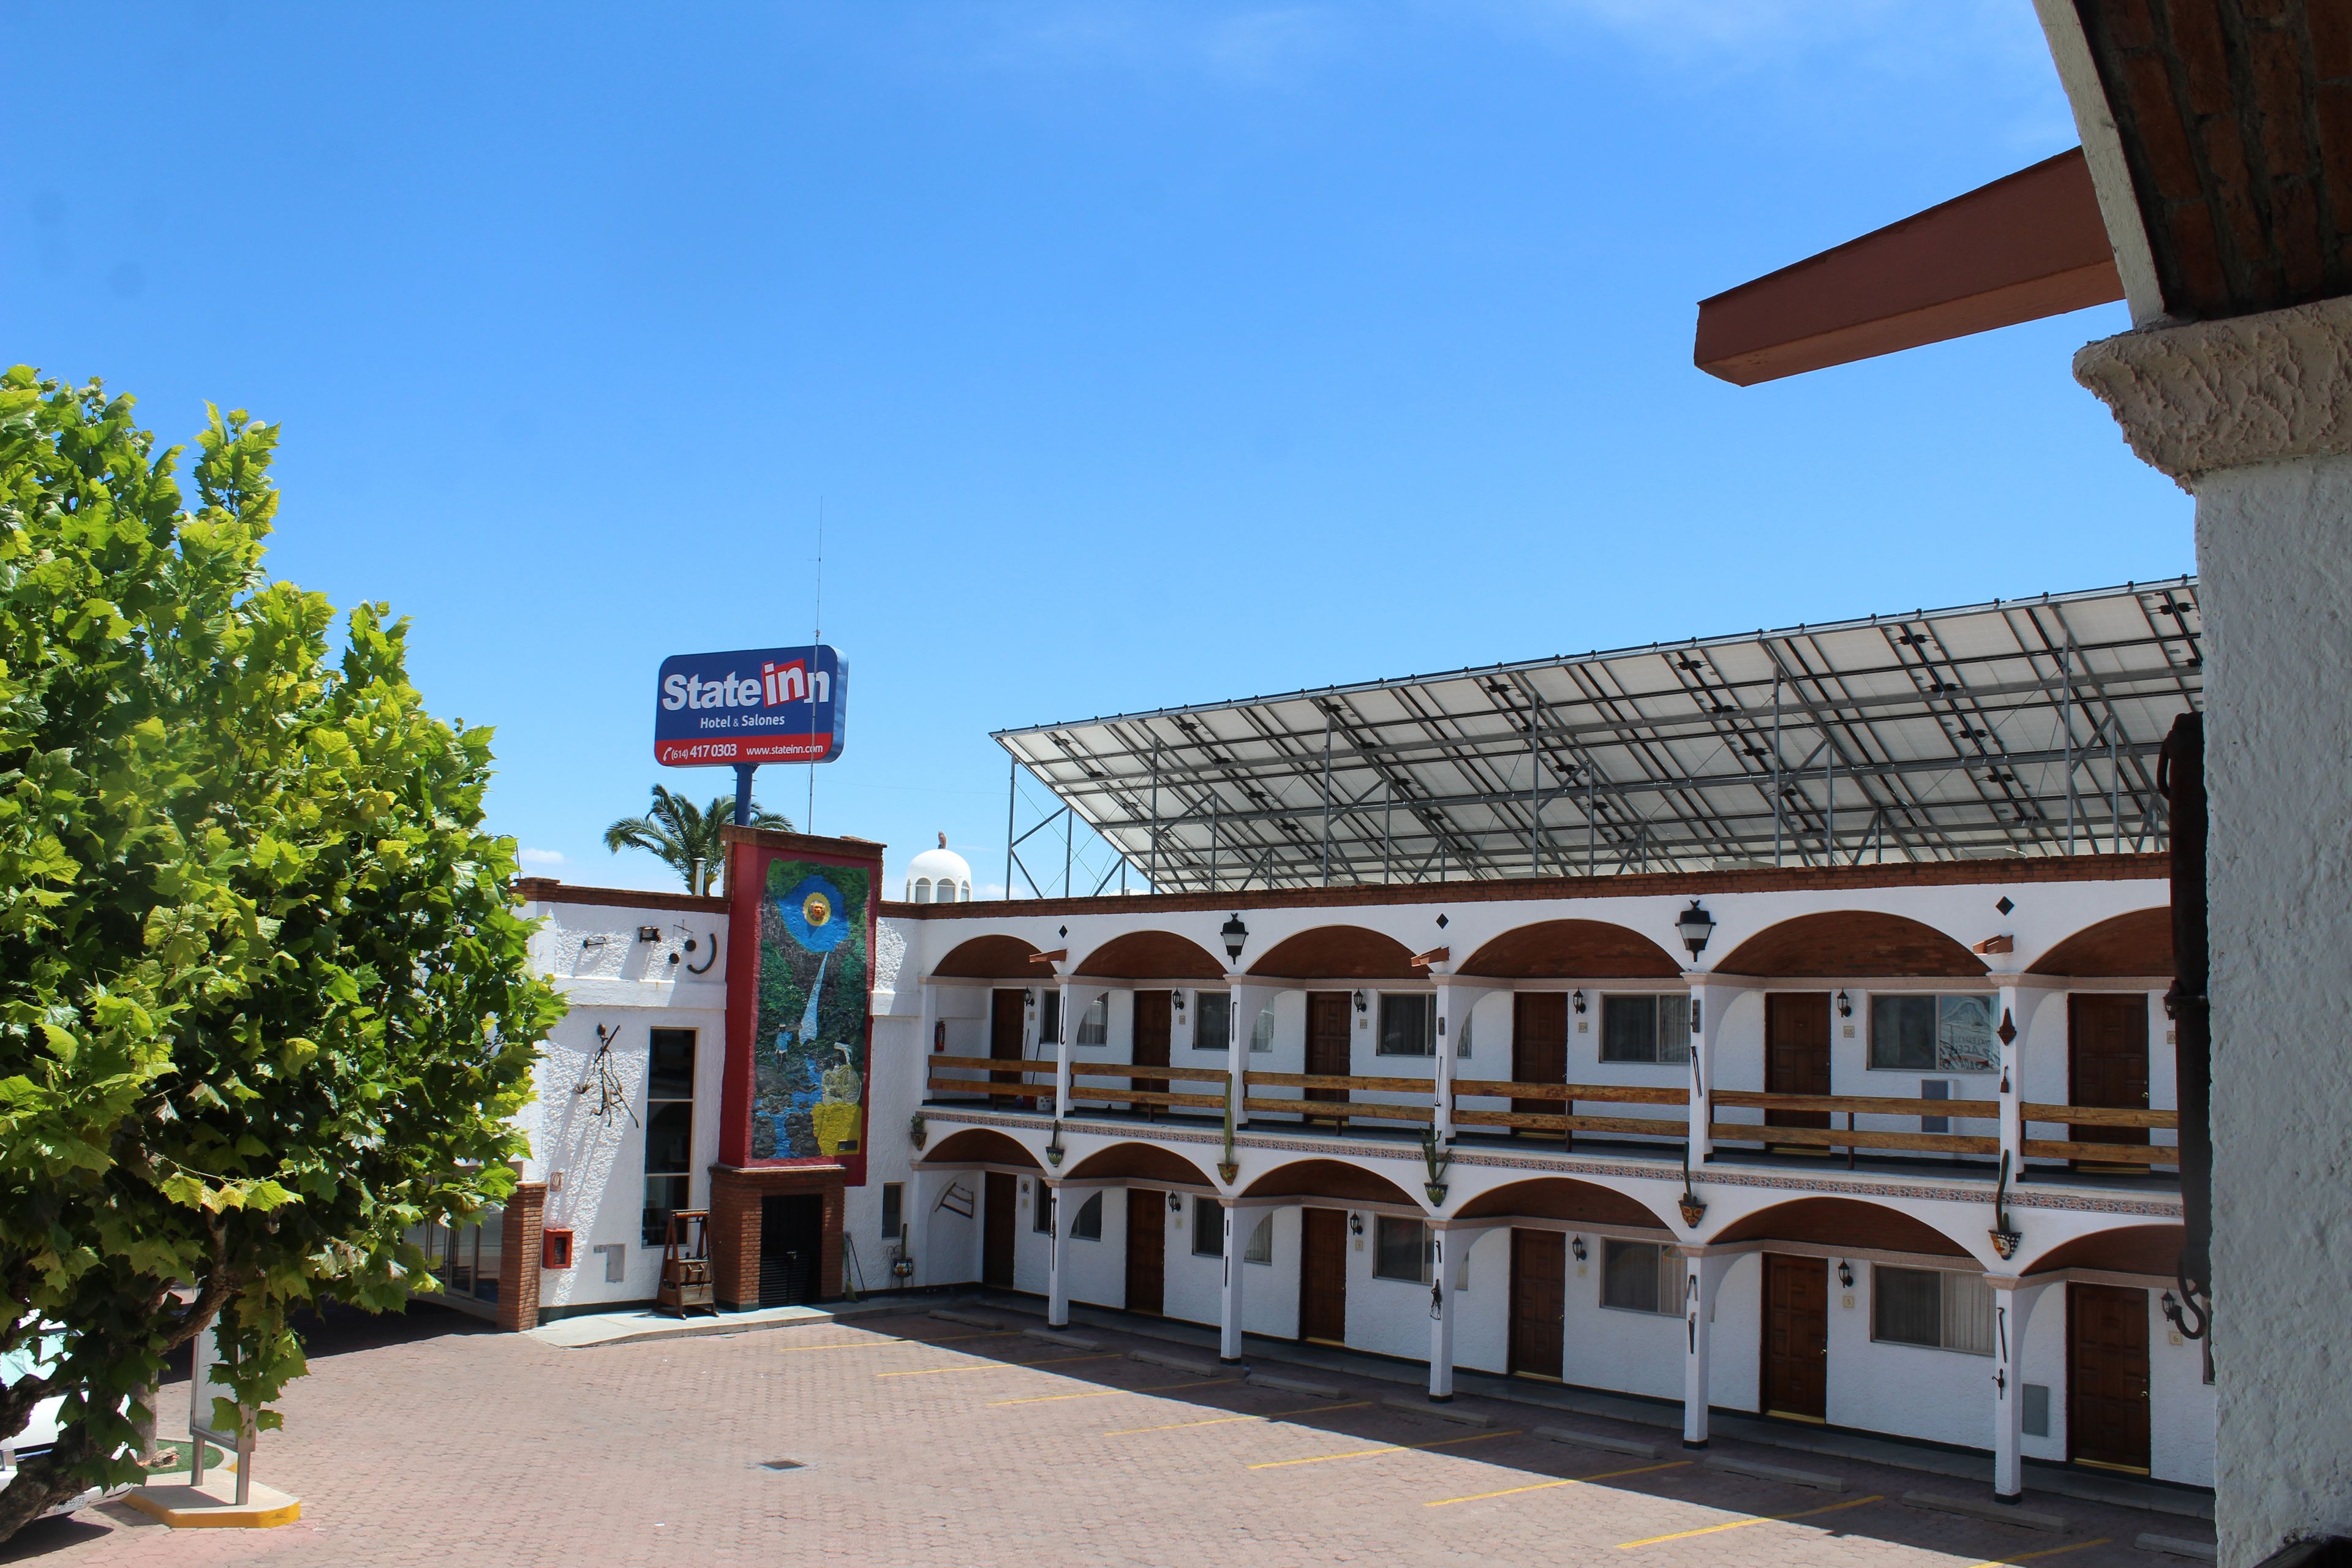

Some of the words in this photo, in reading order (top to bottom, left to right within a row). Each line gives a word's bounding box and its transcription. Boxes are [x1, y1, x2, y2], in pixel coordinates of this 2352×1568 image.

[700, 717, 730, 729] Hotel
[733, 719, 739, 728] &
[741, 714, 785, 726] Salones
[671, 748, 688, 760] (614)
[690, 745, 710, 758] 417
[711, 744, 737, 757] 0303
[746, 744, 823, 755] www.stateinn.com
